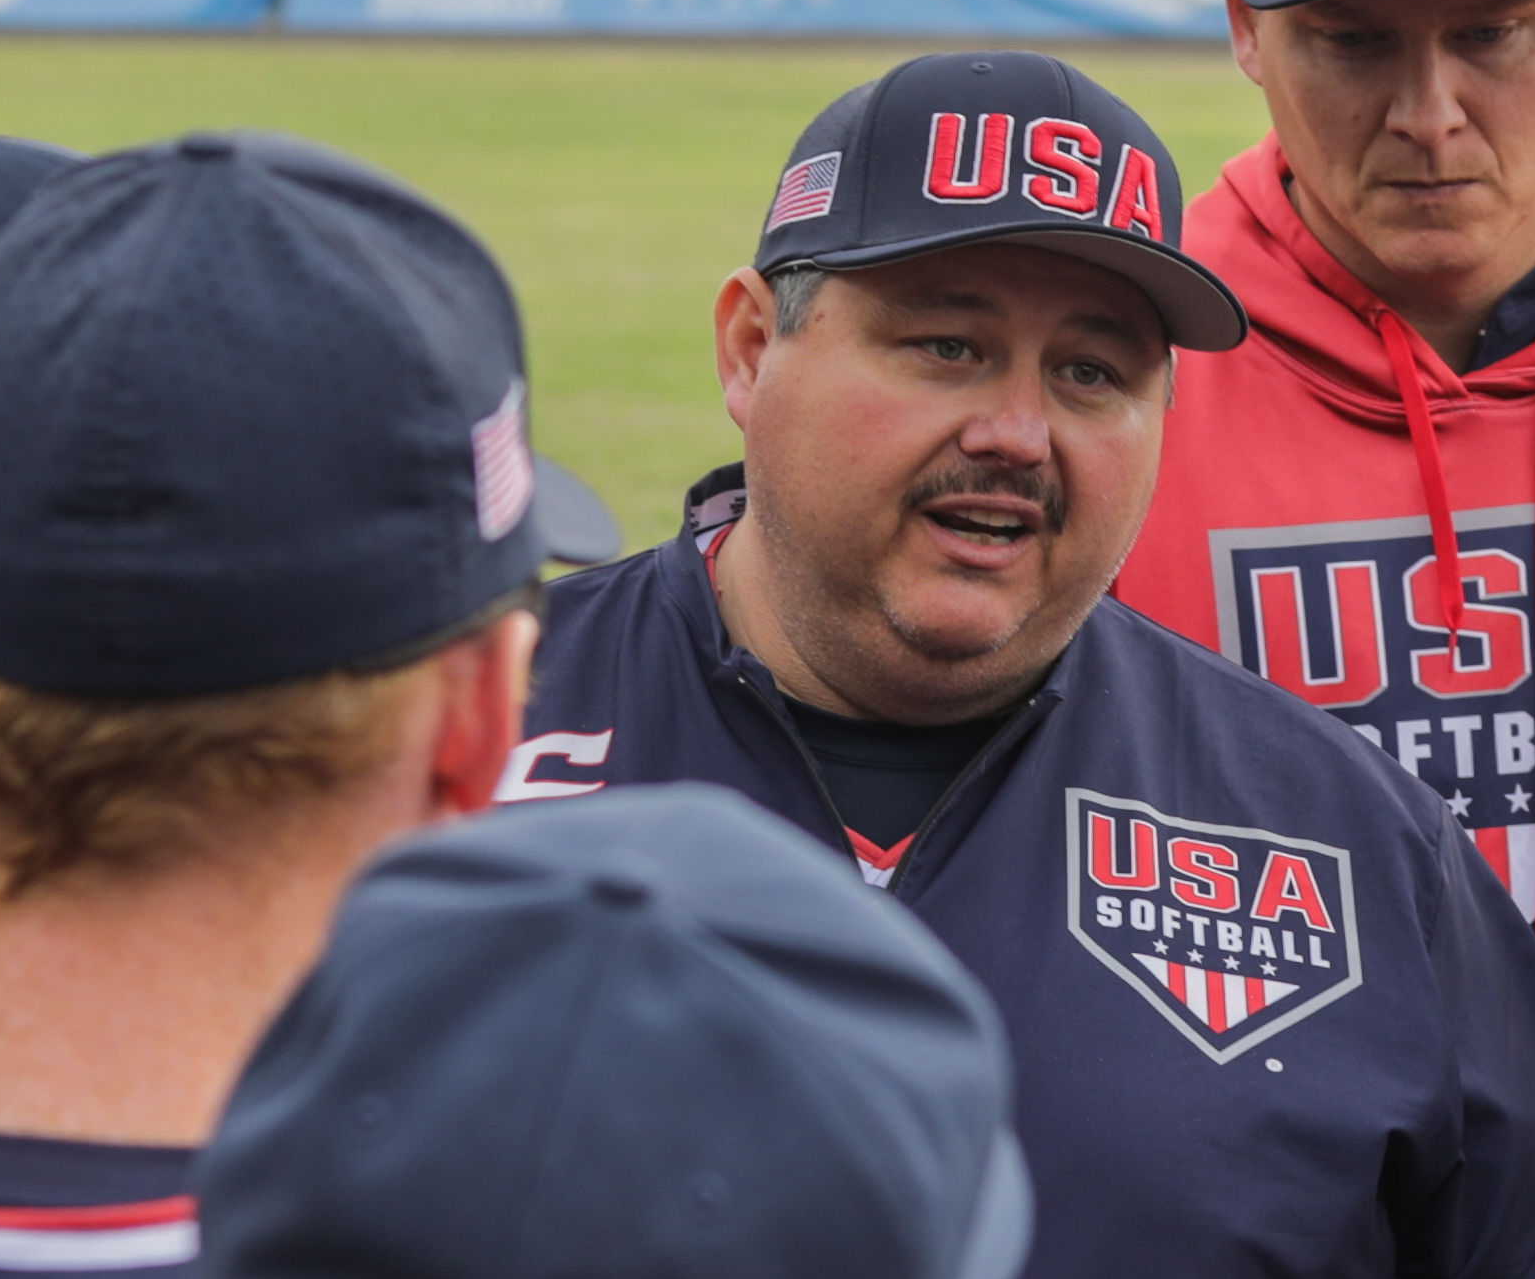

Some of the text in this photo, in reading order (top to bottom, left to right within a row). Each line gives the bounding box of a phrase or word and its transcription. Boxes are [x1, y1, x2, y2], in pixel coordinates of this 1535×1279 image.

[923, 112, 1162, 243] USA
[1088, 811, 1336, 933] USA
[1096, 895, 1331, 969] SOFTBALL
